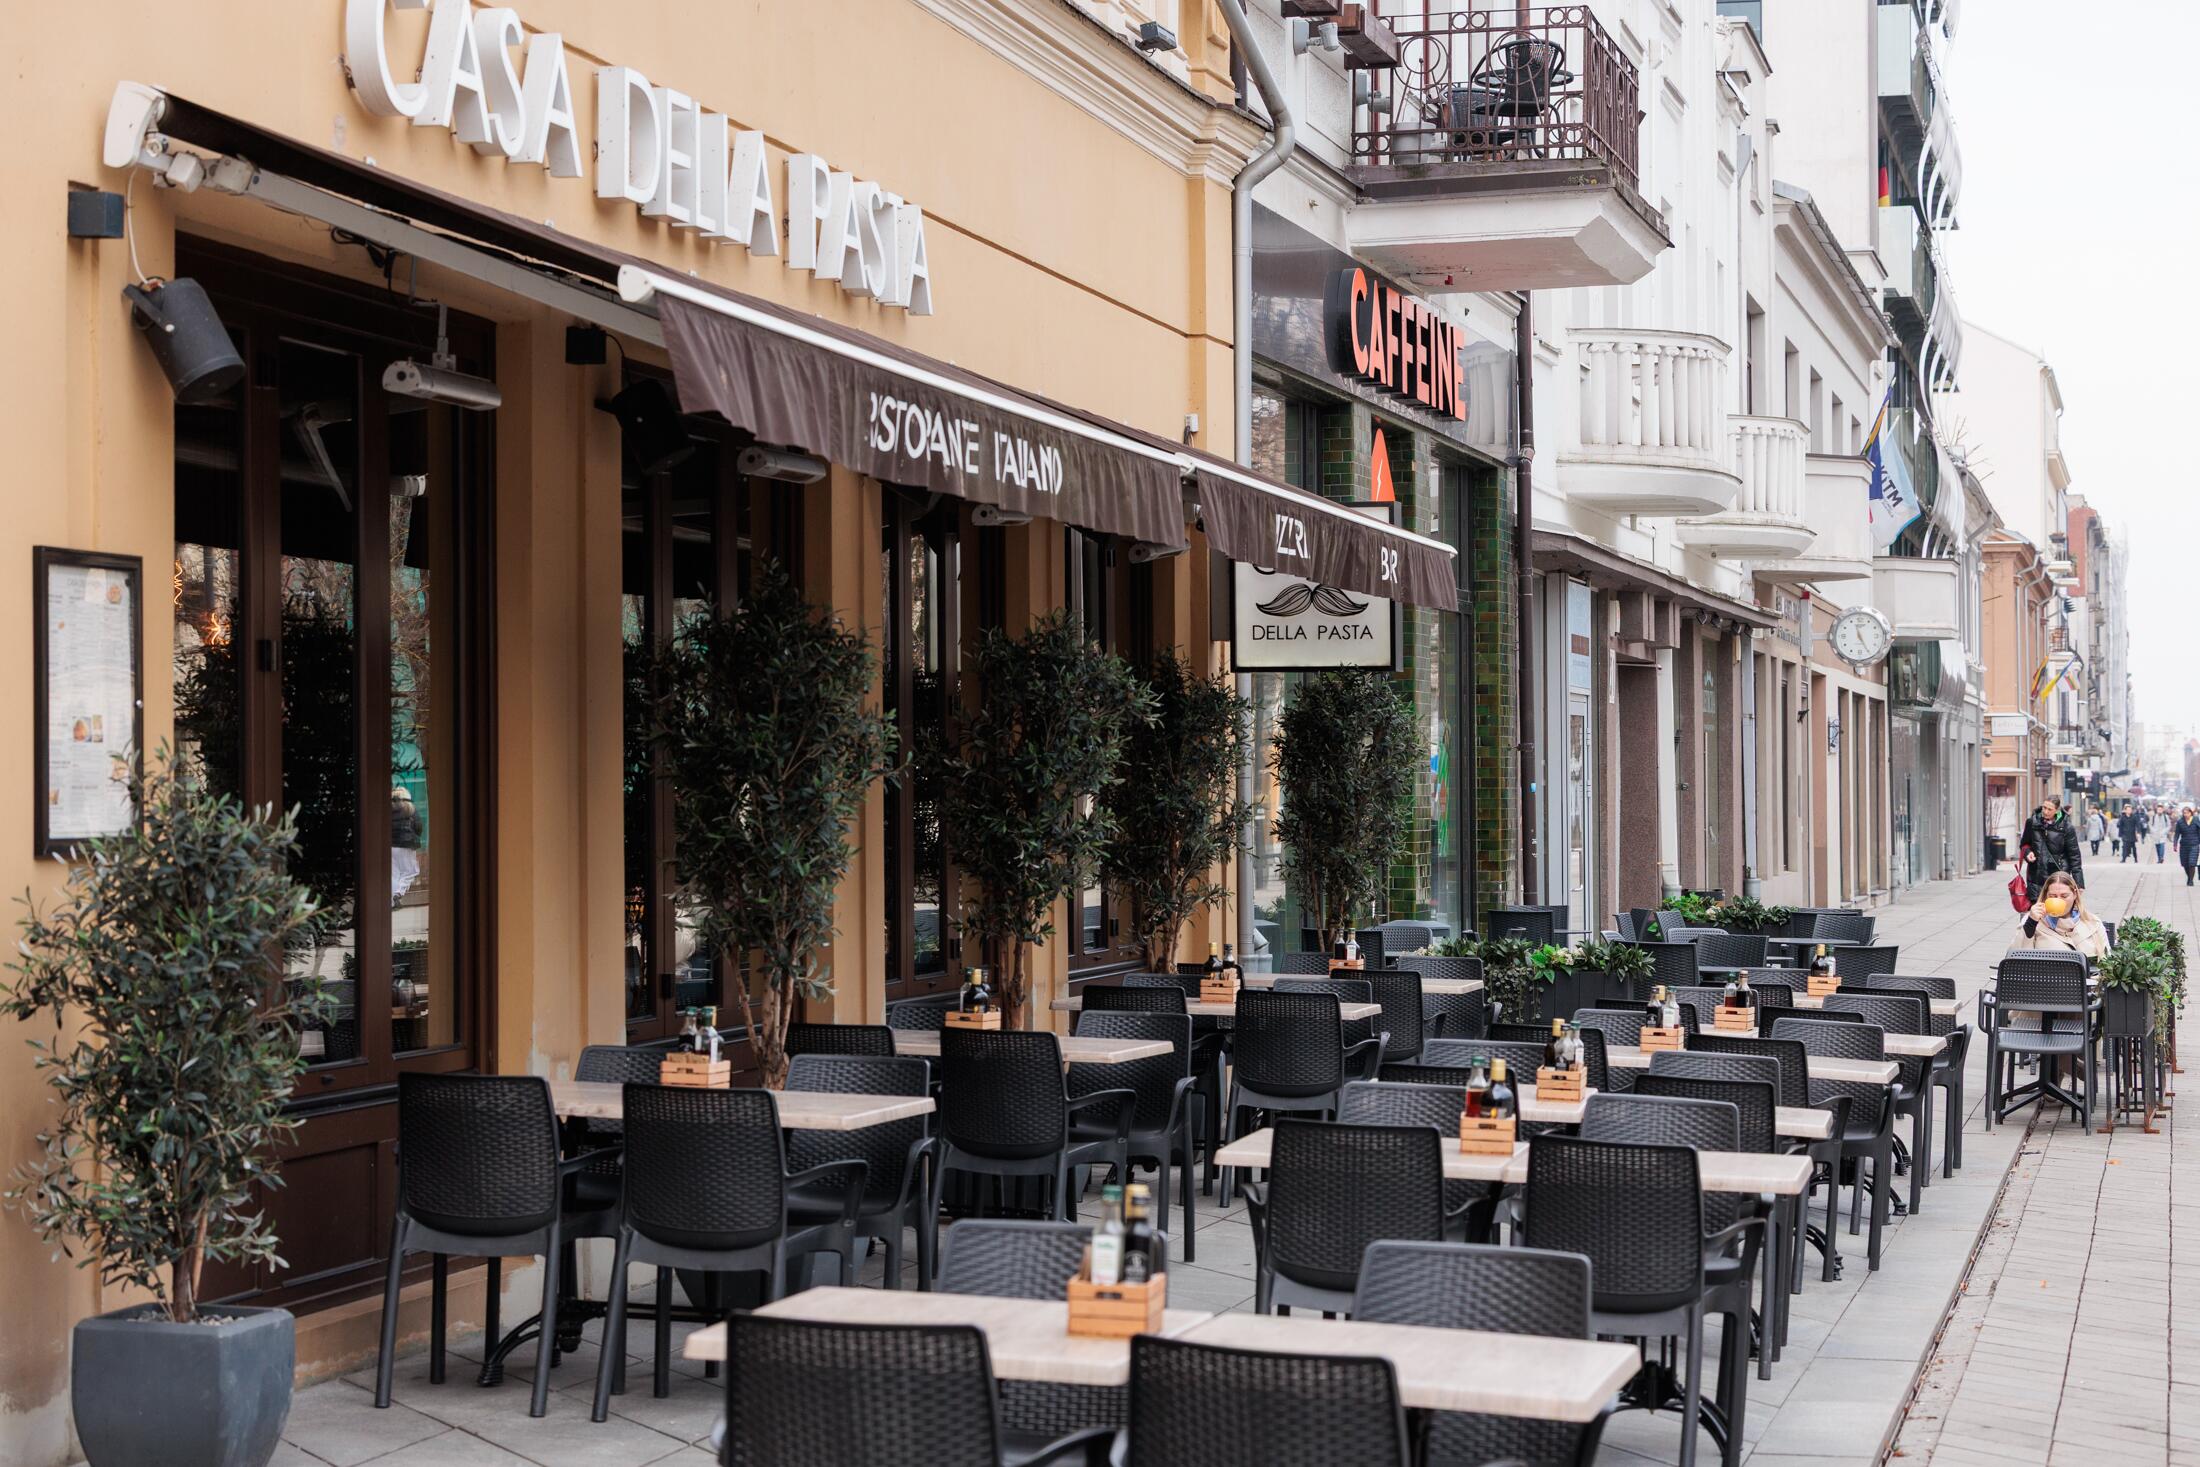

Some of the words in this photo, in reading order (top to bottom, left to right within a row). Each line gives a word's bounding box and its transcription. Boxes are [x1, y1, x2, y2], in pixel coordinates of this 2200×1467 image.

[346, 0, 583, 178] CASA
[597, 66, 778, 256] DELLA
[788, 153, 933, 316] PASTA
[1350, 267, 1466, 422] CAFFEINE
[1252, 625, 1307, 640] DELLA
[1317, 625, 1373, 640] PASTA
